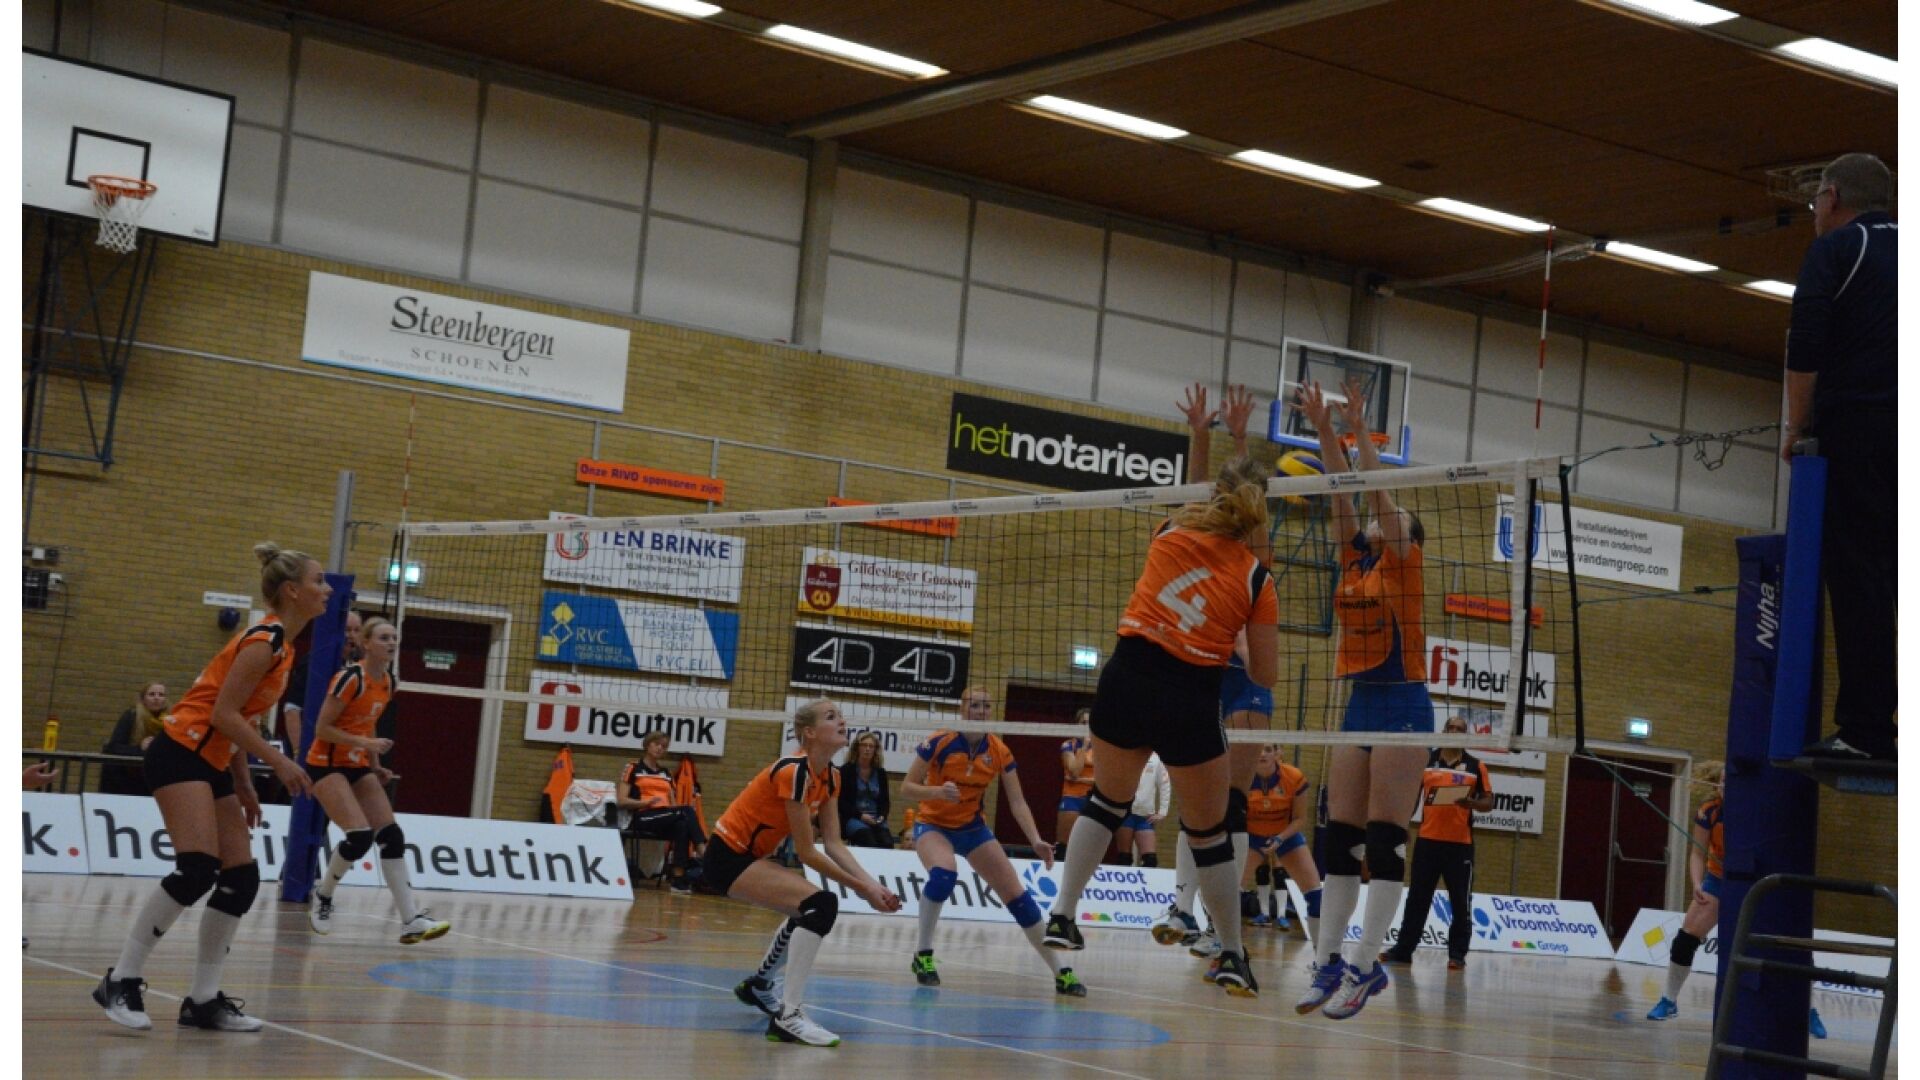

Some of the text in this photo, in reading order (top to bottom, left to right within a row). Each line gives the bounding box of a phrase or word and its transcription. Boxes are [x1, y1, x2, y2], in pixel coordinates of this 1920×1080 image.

[391, 296, 554, 362] Steenbergen
[410, 347, 530, 377] SCHOENEN
[954, 412, 1184, 486] hetnotarieel
[611, 468, 639, 481] RIVO
[643, 475, 697, 490] sponsoren
[651, 533, 730, 560] BRINKE
[1611, 541, 1652, 555] onderhoud
[848, 559, 919, 581] Gildeslager
[1157, 566, 1214, 633] 4
[1756, 582, 1779, 650] Nijha
[576, 628, 608, 644] RVC
[807, 637, 956, 684] 4D 4D
[1093, 867, 1148, 884] Groot
[1114, 911, 1153, 926] Groep
[1499, 915, 1598, 939] Vroomshoop
[1538, 940, 1569, 952] Groep
